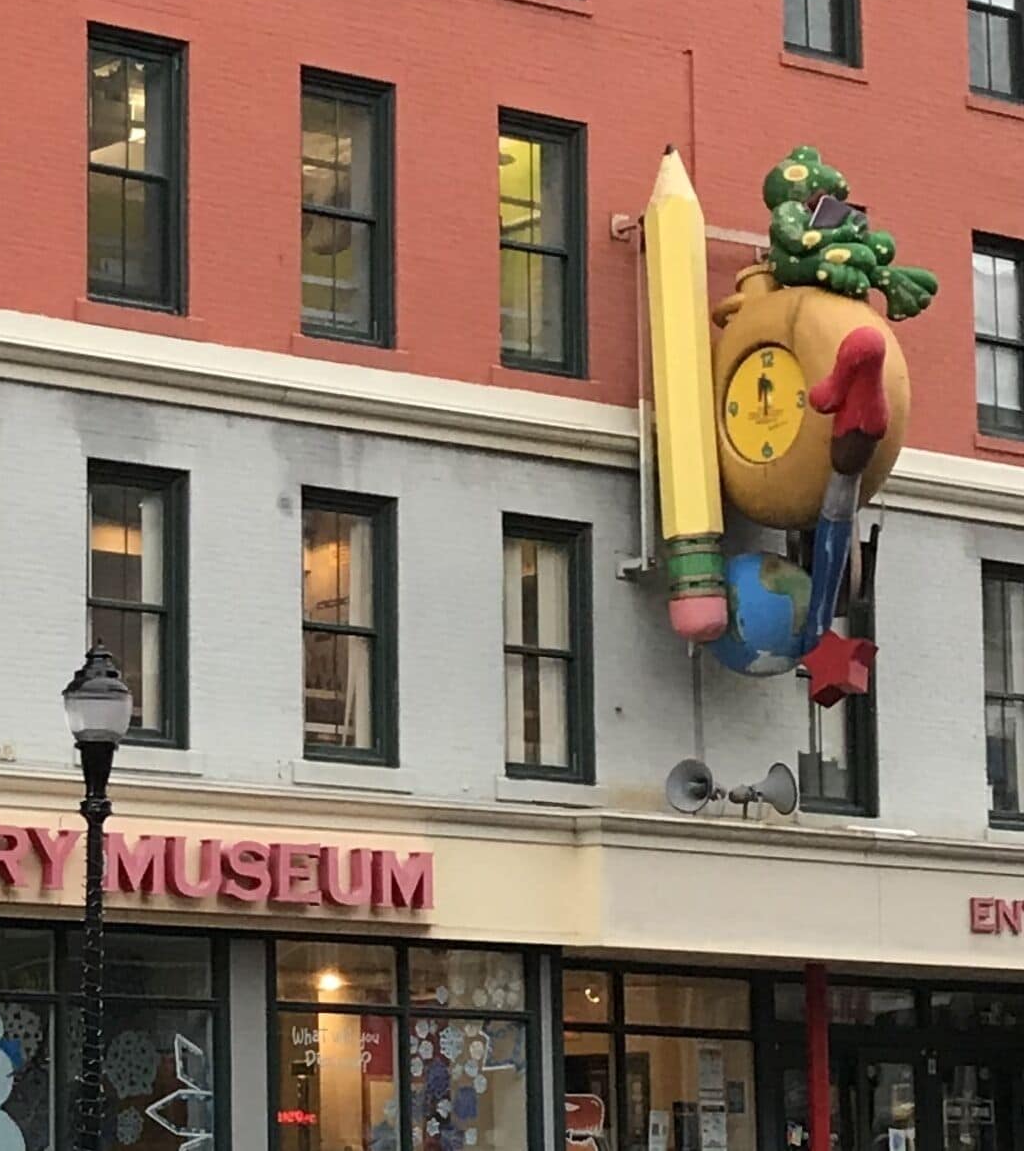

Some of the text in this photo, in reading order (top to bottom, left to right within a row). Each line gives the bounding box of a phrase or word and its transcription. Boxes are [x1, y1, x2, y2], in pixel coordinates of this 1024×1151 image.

[760, 351, 774, 368] 12
[796, 390, 805, 408] 3
[102, 831, 435, 910] MUSEUM
[969, 896, 1024, 936] EN
